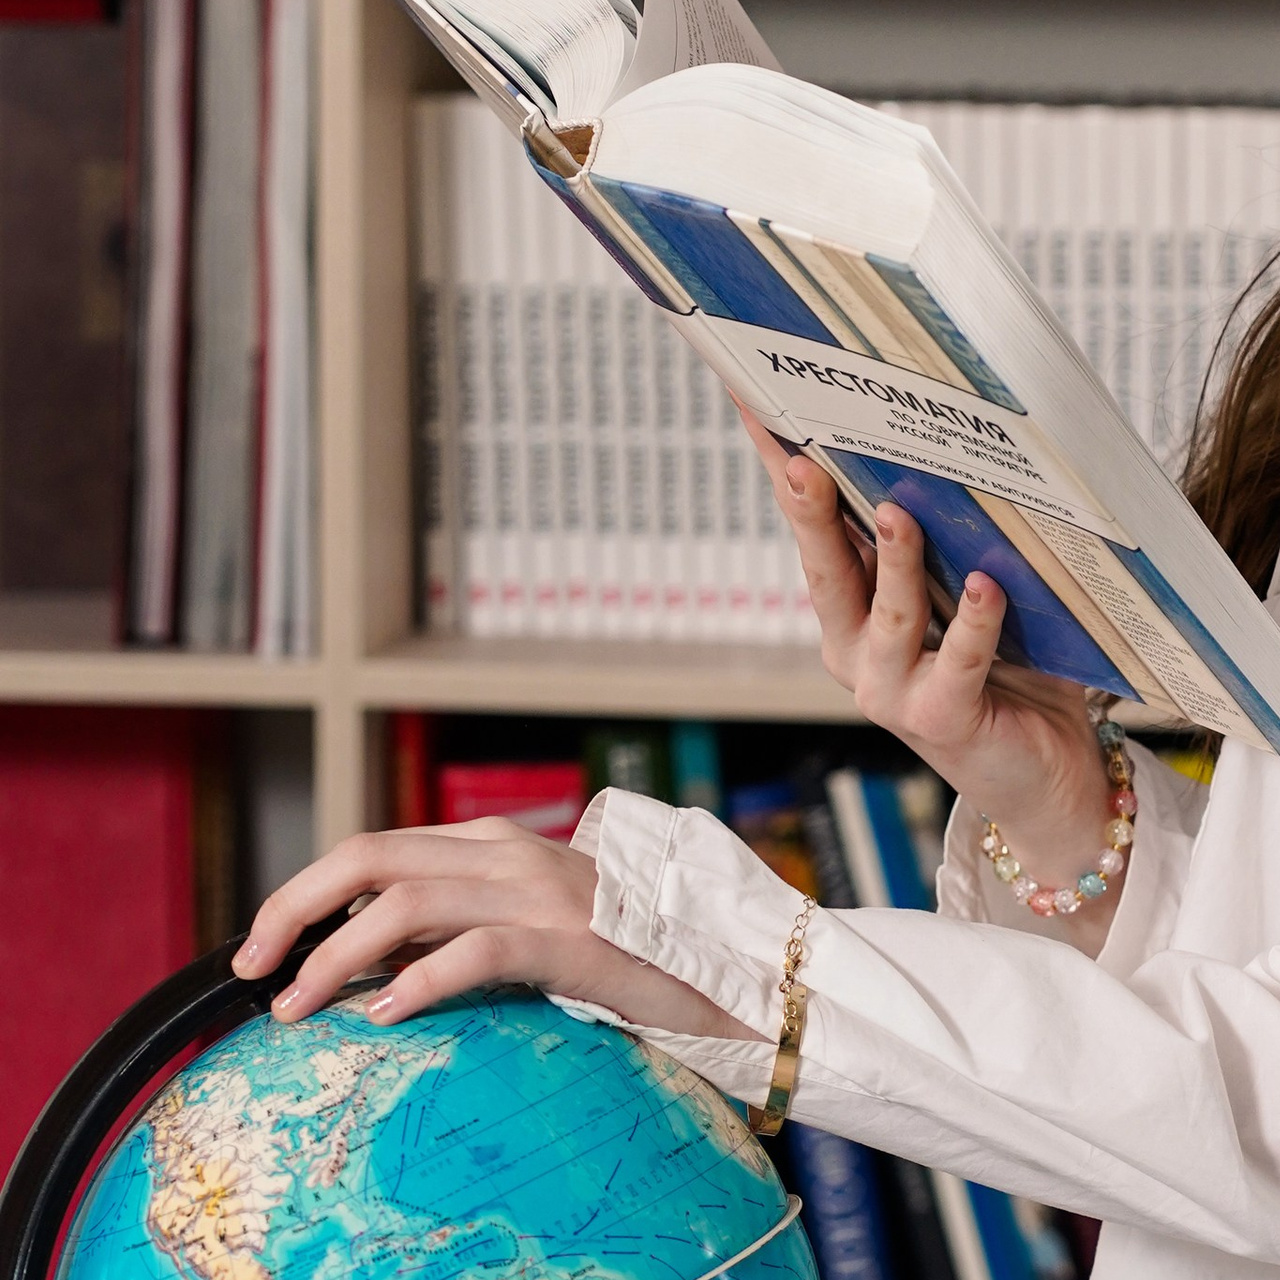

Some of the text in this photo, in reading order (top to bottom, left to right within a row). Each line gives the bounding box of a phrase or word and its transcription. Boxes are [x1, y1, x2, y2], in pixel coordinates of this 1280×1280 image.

[756, 347, 1017, 448] ХРЕСТОМАТИЯ
[886, 420, 1048, 484] РУССКОЙ ЛИТЕРАТУРЕ
[889, 408, 1034, 468] ПО СОВРЕМЕННОЙ
[831, 433, 1076, 520] ДЛЯ СТАРШЕКЛАССНИКОВ И АБИТУРИЕНТОВ
